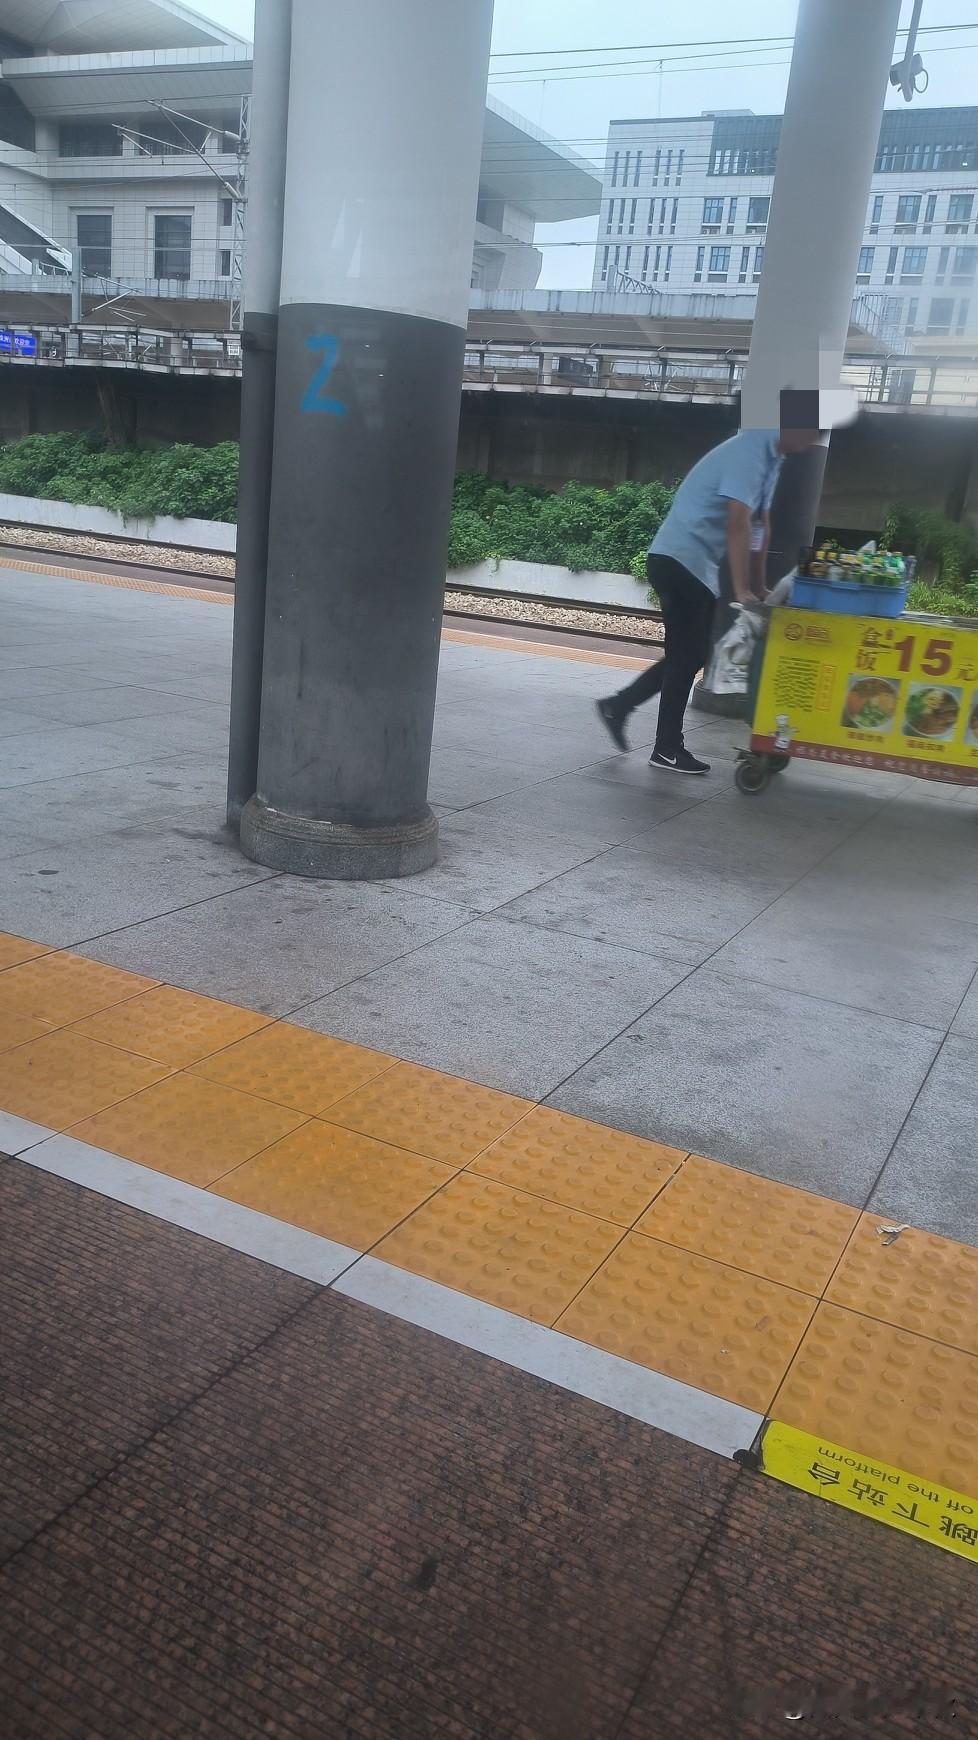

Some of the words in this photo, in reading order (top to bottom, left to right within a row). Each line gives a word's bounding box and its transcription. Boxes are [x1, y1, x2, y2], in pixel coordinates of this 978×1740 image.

[302, 333, 347, 416] 2
[818, 1446, 901, 1485] platform
[808, 1462, 978, 1546] 跳下站台
[907, 1482, 939, 1502] the
[945, 1499, 974, 1515] off
